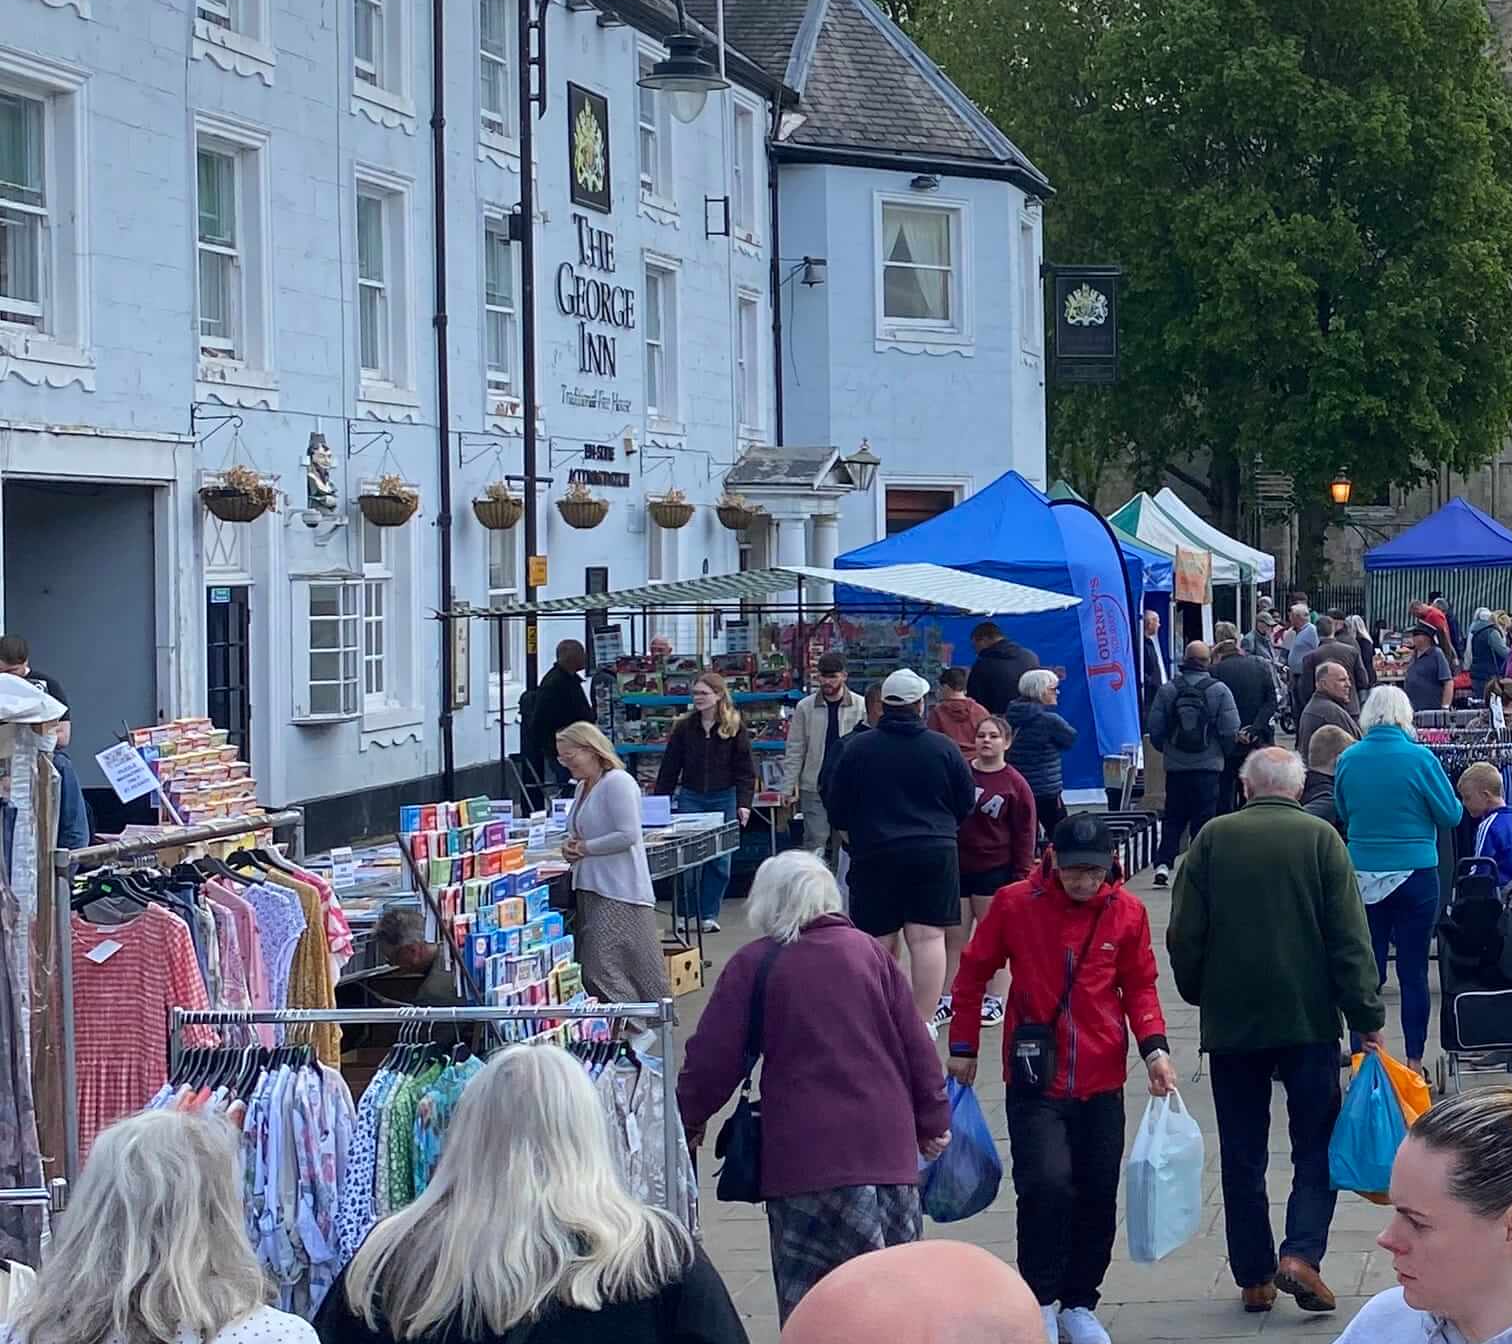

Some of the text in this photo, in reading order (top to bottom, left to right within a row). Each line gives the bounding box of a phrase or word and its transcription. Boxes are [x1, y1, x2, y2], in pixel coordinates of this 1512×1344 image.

[573, 213, 616, 273] THE
[556, 261, 635, 330] GEORGE
[577, 320, 617, 378] INN
